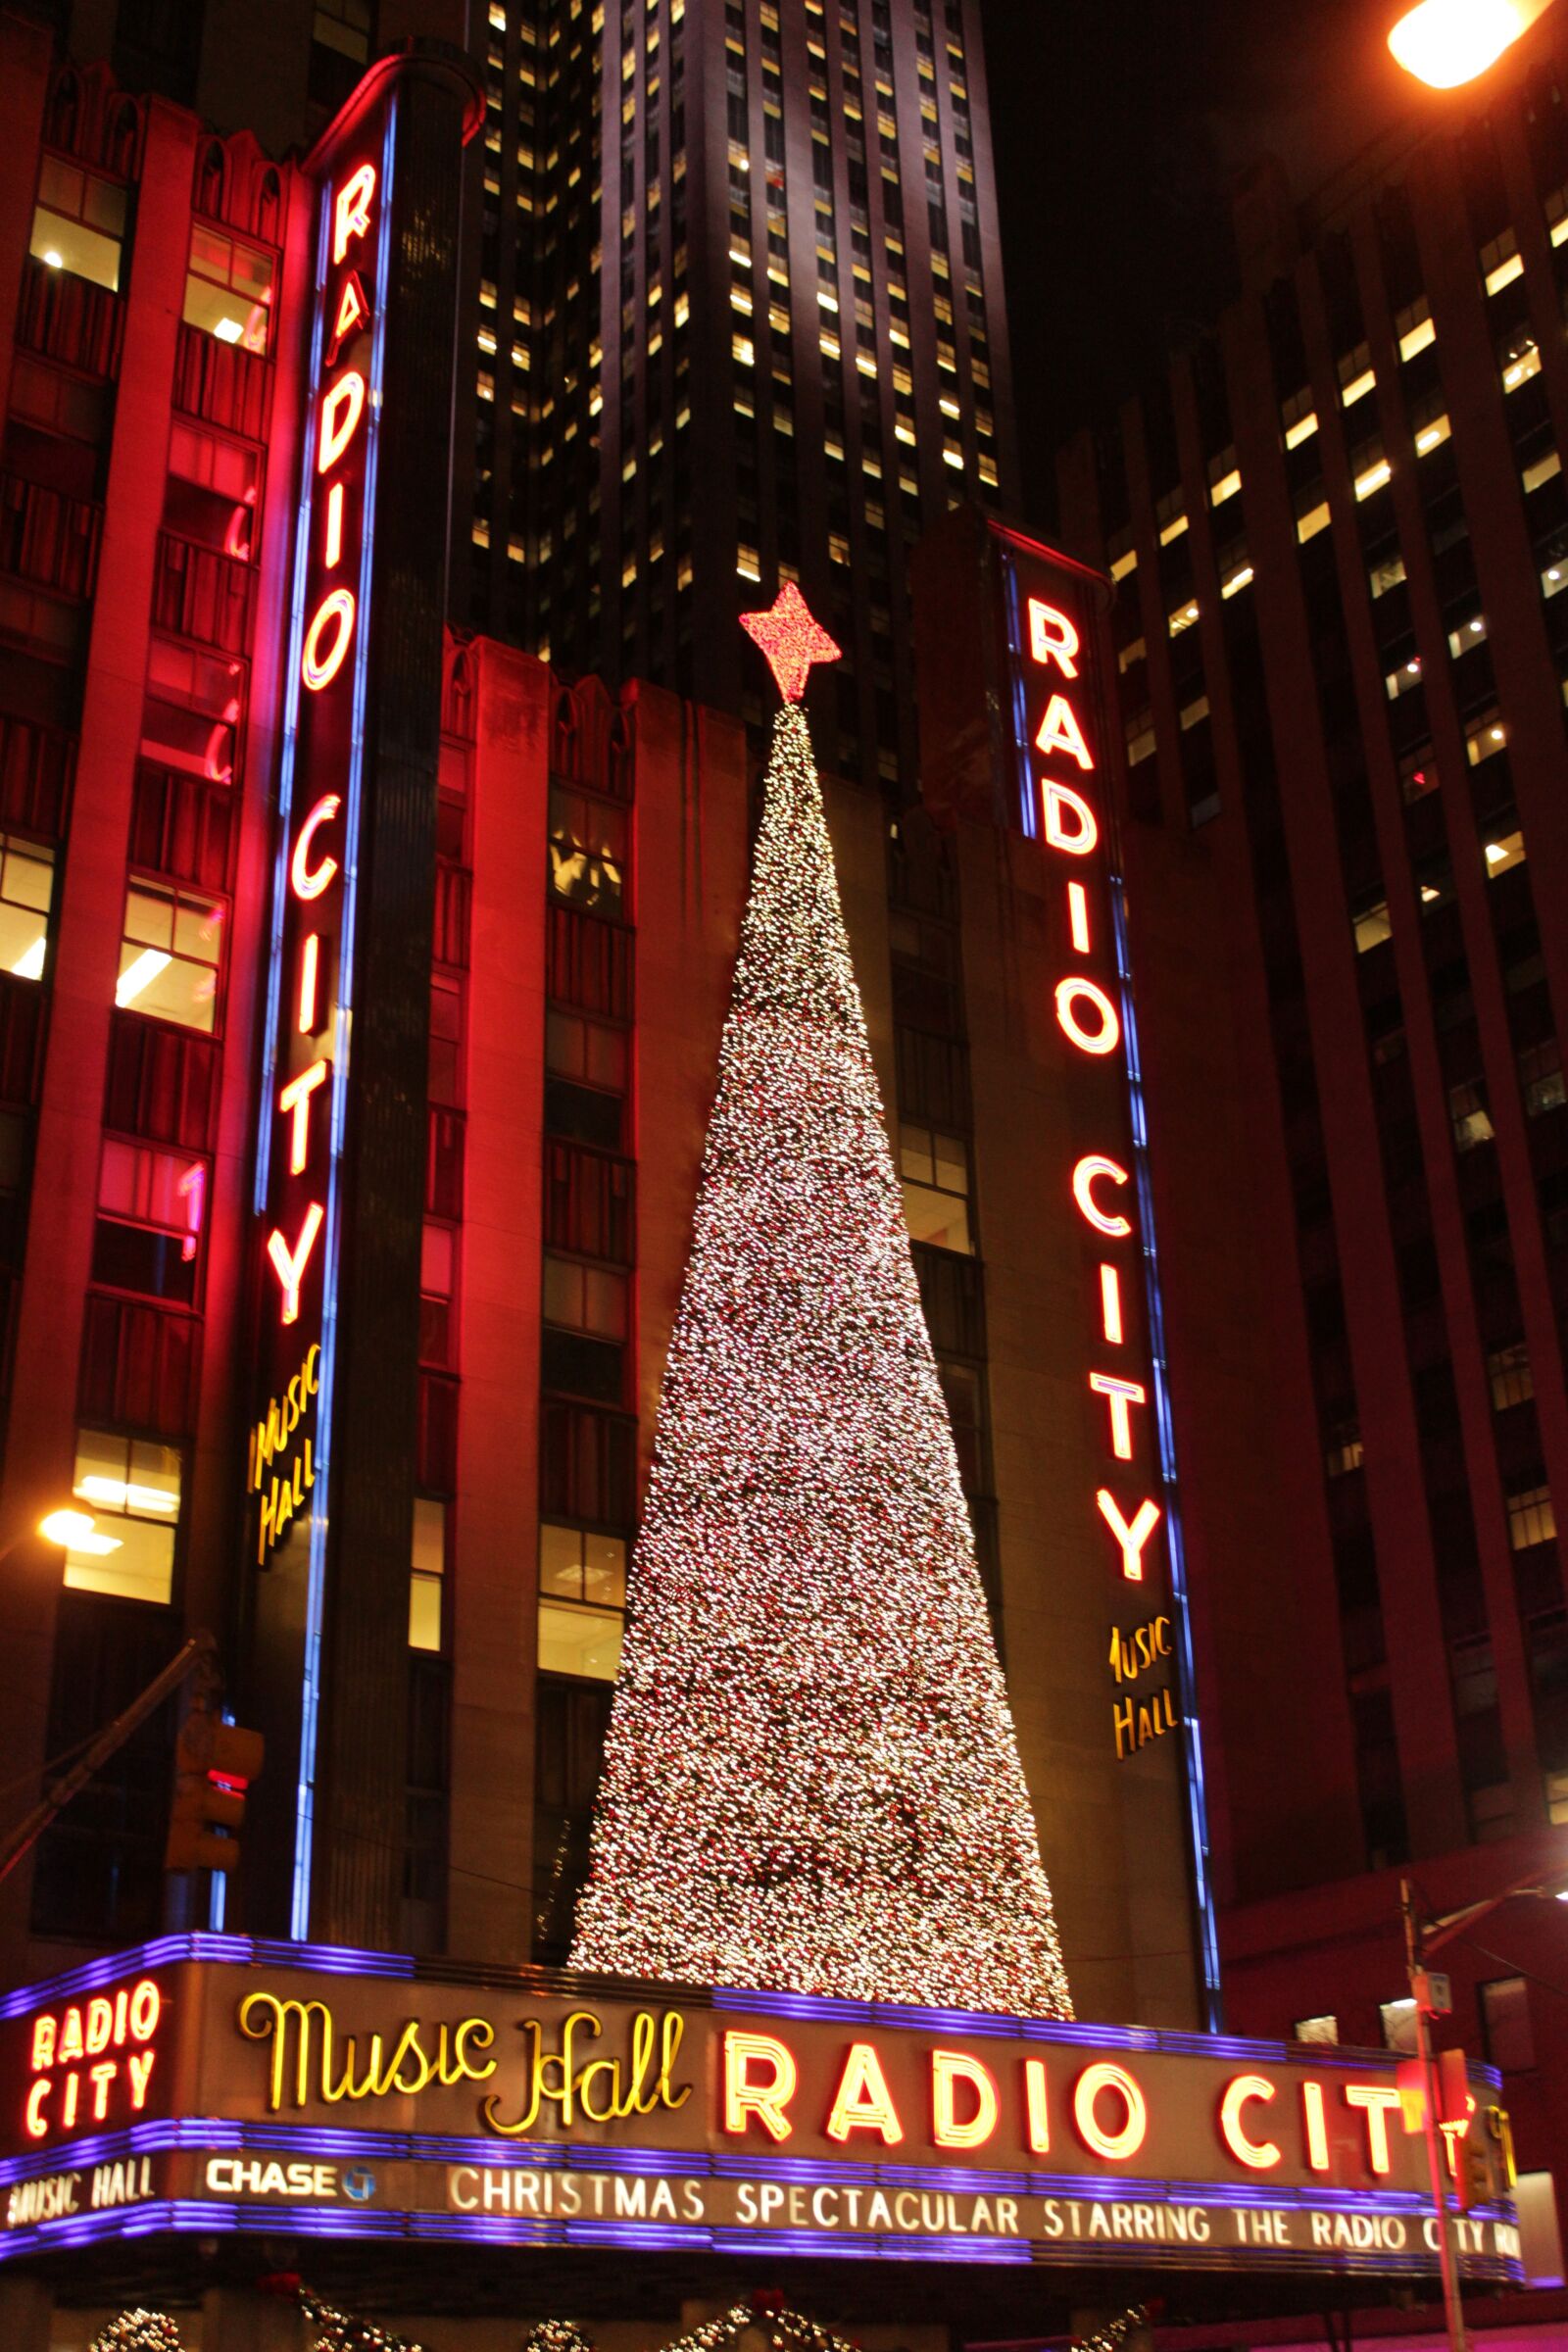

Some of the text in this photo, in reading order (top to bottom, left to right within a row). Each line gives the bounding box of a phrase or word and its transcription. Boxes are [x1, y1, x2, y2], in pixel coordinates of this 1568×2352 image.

[266, 163, 376, 1327] RADIO CITY
[1026, 595, 1160, 1581] RADIO CITY
[247, 1344, 321, 1494] MUSIC
[258, 1437, 316, 1566] HALL
[1112, 1689, 1178, 1760] HALL
[31, 1980, 160, 2071] RADIO
[239, 1991, 692, 2136] Music Hall
[25, 2050, 155, 2137] CITY
[723, 2028, 1149, 2162] RADIO
[8, 2156, 155, 2228] MUSIC HALL
[207, 2158, 337, 2198] CHASE
[448, 2166, 705, 2221] CHRISTMAS
[735, 2182, 1020, 2234] SPECTACULAR
[1043, 2198, 1211, 2243] STARRING
[1232, 2207, 1294, 2246] THE
[1311, 2211, 1407, 2251] RADIO
[1422, 2217, 1485, 2253] CTY
